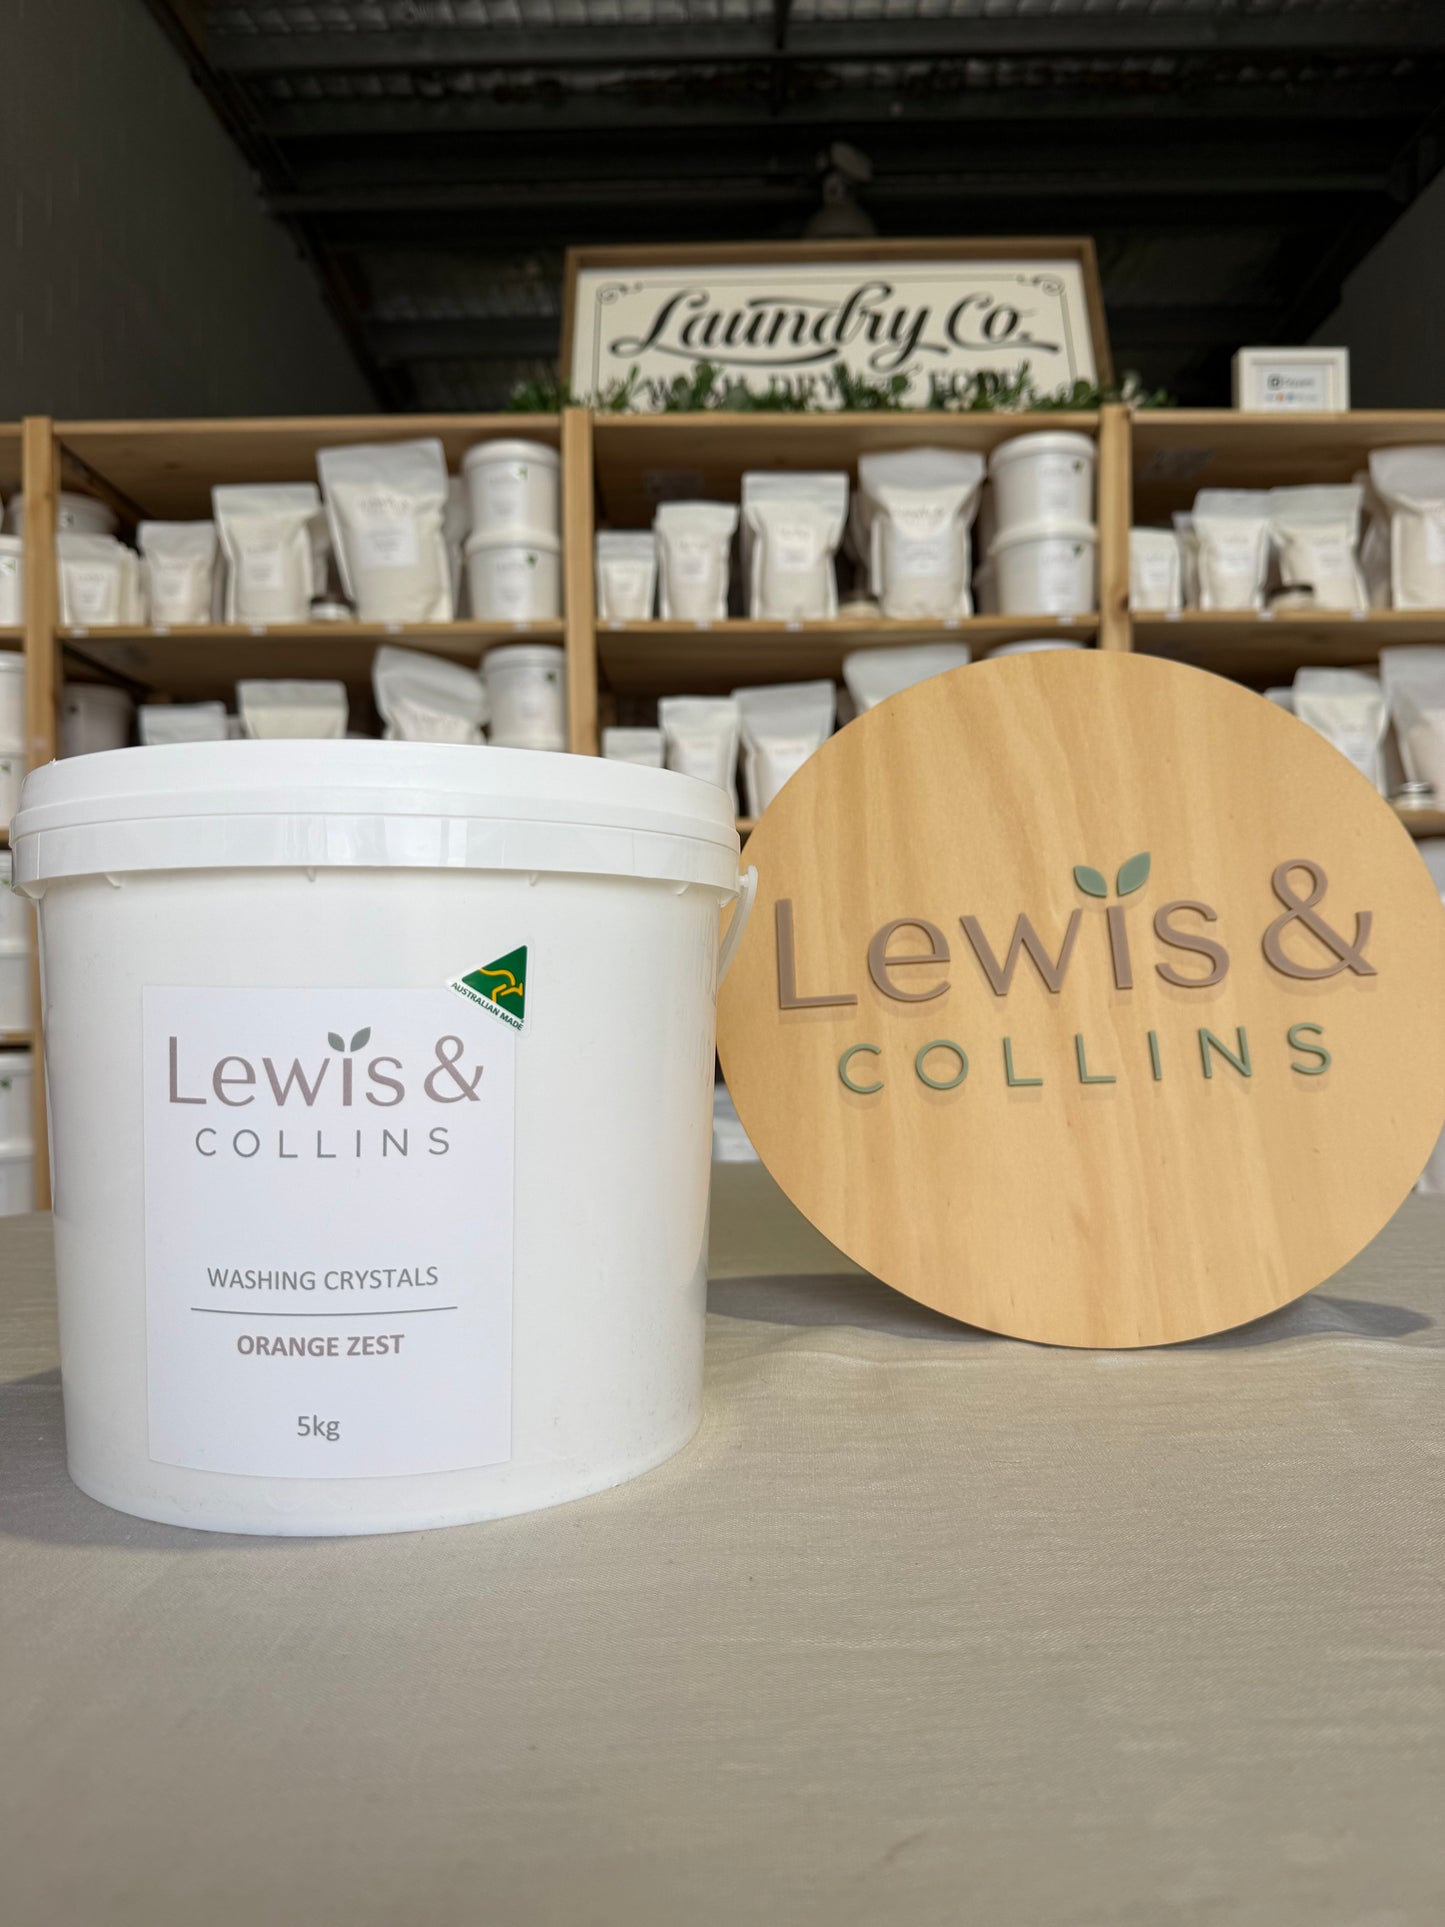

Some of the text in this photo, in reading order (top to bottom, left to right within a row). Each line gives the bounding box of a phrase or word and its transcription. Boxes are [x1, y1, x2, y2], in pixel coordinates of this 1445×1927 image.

[610, 282, 949, 372] Laundry
[775, 852, 1378, 1010] Lewis &
[451, 982, 524, 1031] AUSTRALIAN MADE
[169, 1026, 485, 1106] Lewis &
[838, 1023, 1333, 1096] COLLINS
[195, 1127, 451, 1159] COLLINS
[207, 1265, 439, 1292] WASHING CRYSTALS
[236, 1333, 405, 1358] ORANGE ZEST
[296, 1414, 341, 1442] 5kg
